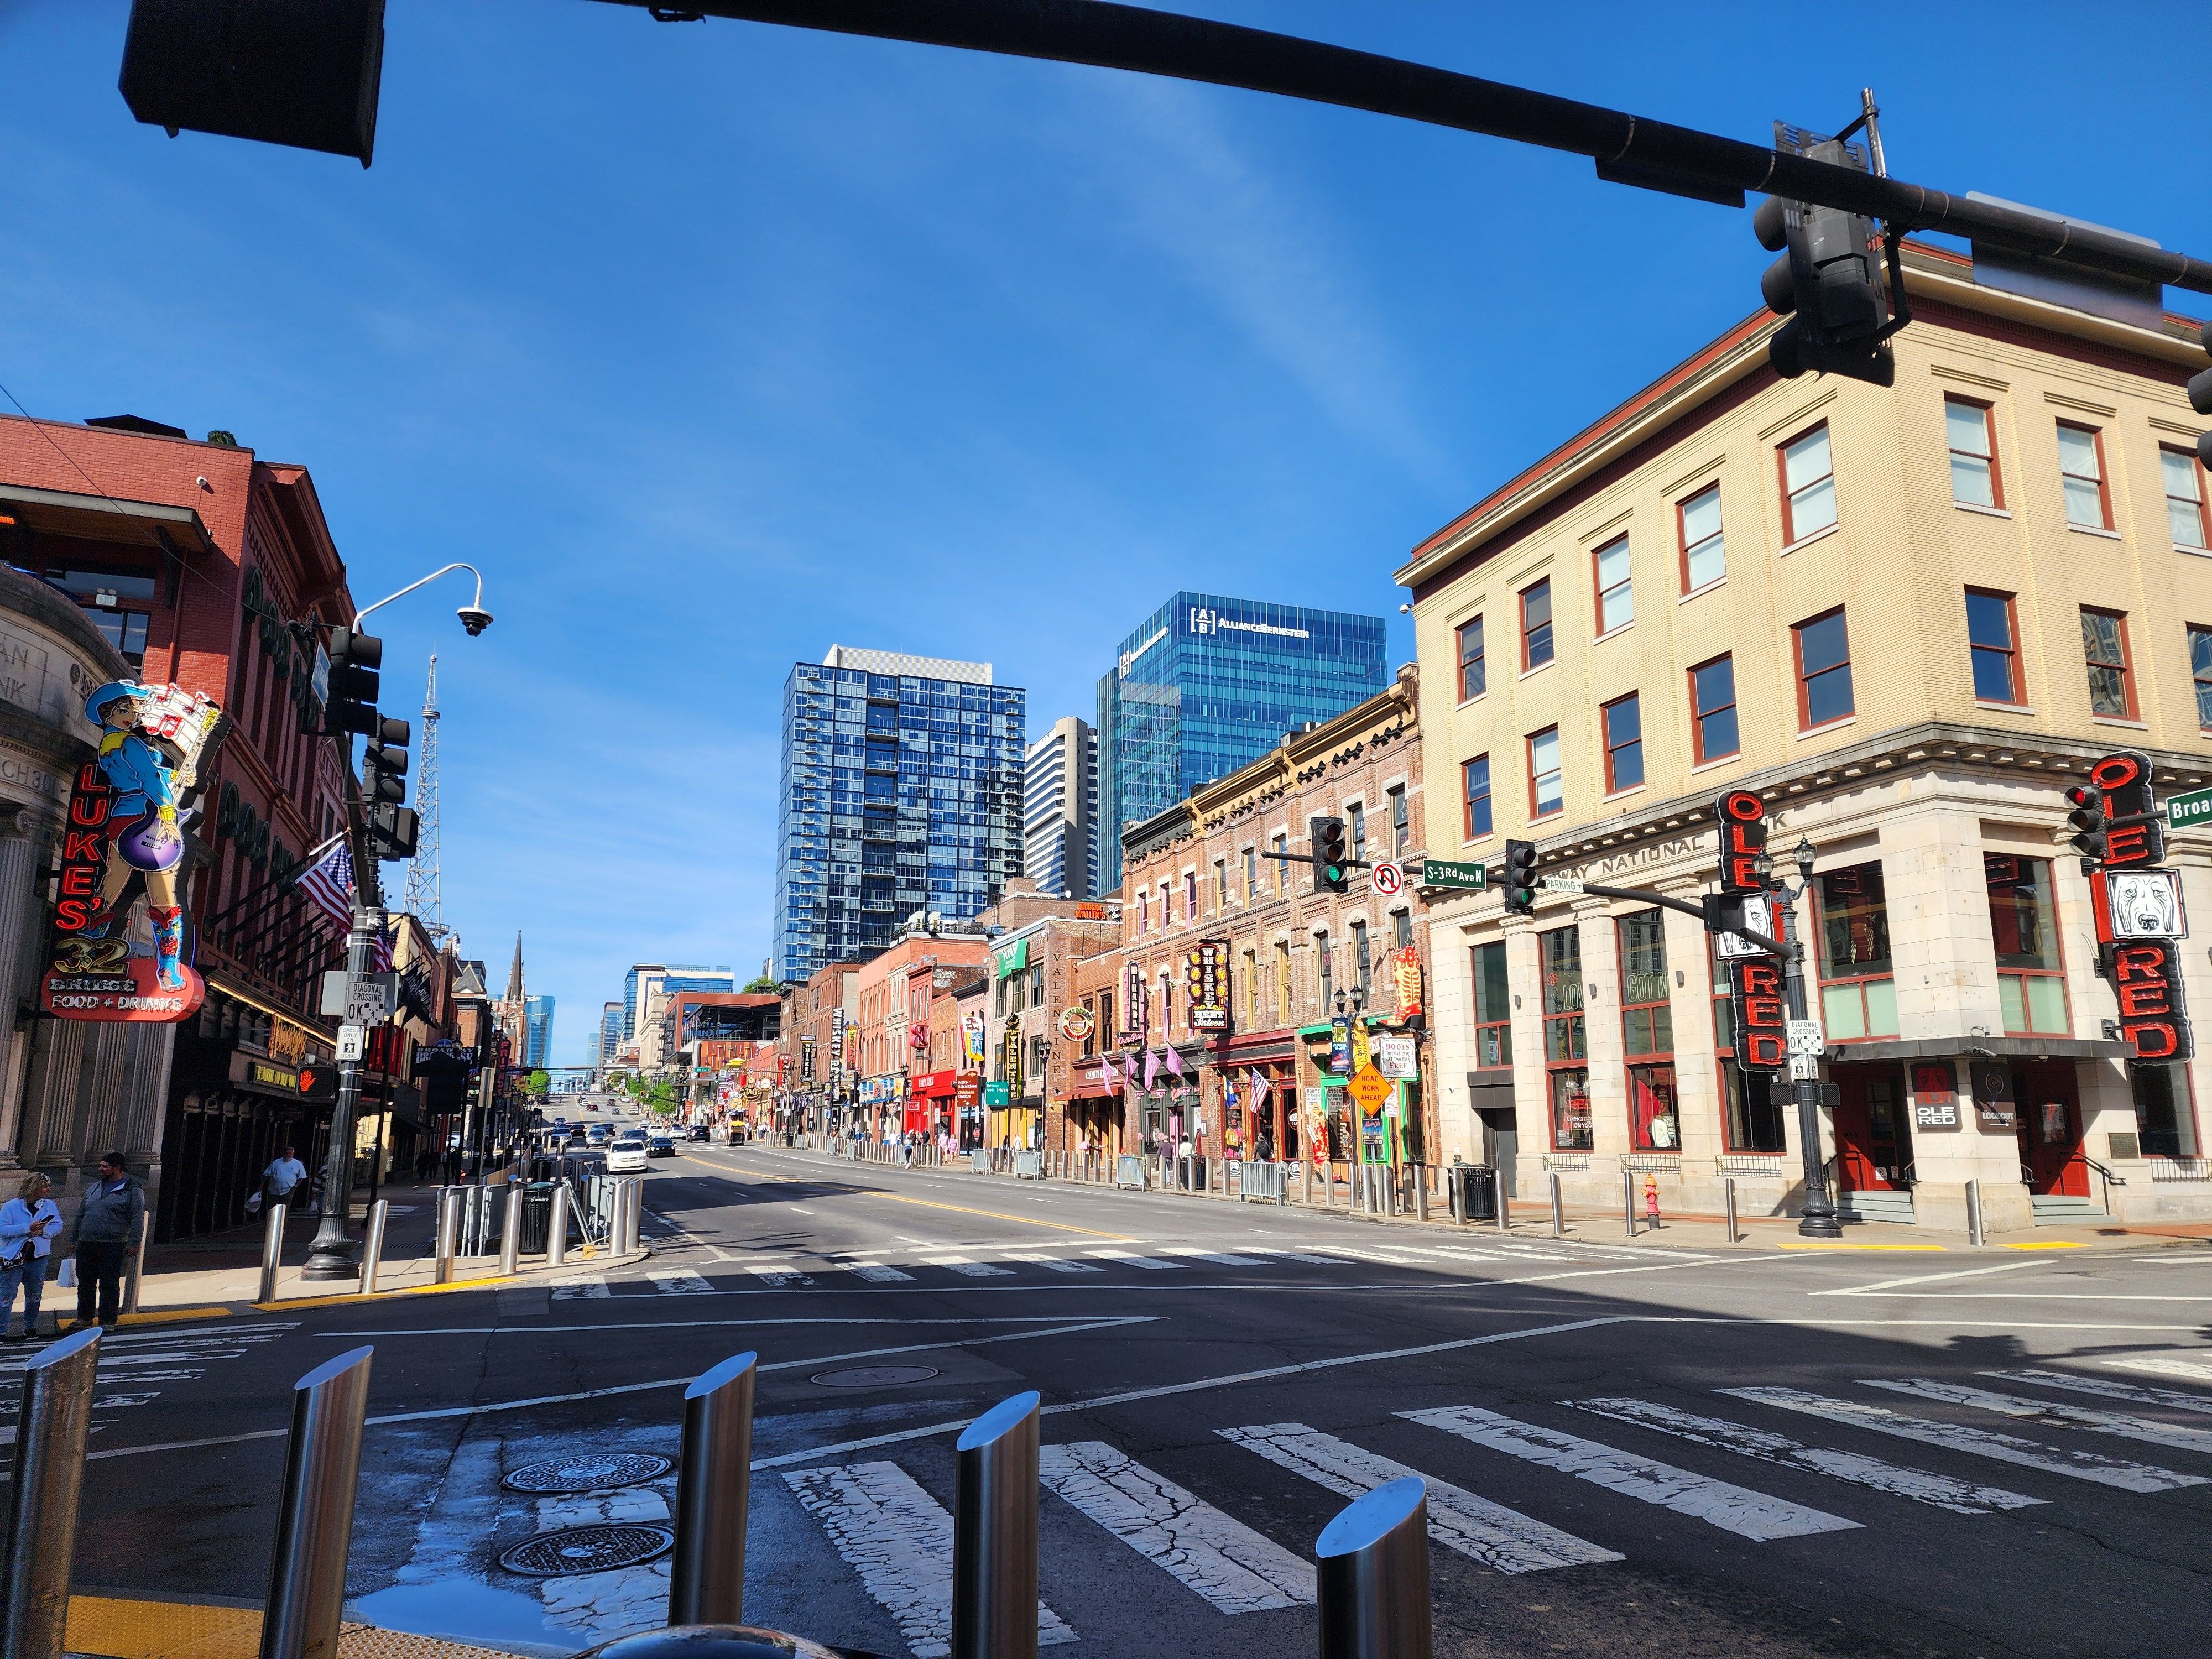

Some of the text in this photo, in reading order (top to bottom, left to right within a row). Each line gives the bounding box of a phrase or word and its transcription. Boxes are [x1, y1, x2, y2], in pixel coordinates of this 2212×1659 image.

[1198, 609, 1208, 620] A
[1199, 623, 1208, 634] B
[2172, 800, 2212, 819] Broa
[1729, 792, 1765, 888] OLE
[1602, 836, 1705, 874] NATIONAL
[1458, 872, 1474, 882] Ave
[1475, 870, 1481, 882] N
[1546, 879, 1576, 890] PARKING
[1075, 910, 1107, 920] WALLEN'S
[55, 938, 129, 976] 32
[49, 978, 135, 992] BRIDGE
[1201, 947, 1215, 1010] WHISKEY
[354, 984, 383, 994] DIAGONAL
[1627, 972, 1654, 1003] GOT
[53, 995, 98, 1009] FOOD
[118, 996, 183, 1010] DRINKS
[353, 993, 382, 1003] CROSSING
[2116, 946, 2177, 1058] RED
[348, 1004, 364, 1020] OK
[1053, 954, 1062, 1074] VALENTINE
[1194, 1010, 1225, 1019] BENT
[1744, 964, 1786, 1065] RED
[1194, 1018, 1225, 1027] Saloon
[831, 1008, 842, 1056] WHISKEY
[1790, 1037, 1803, 1049] OK
[1009, 1035, 1018, 1098] VALENTINE
[1086, 1070, 1100, 1080] CANDY
[1917, 1107, 1955, 1116] OLE
[1918, 1115, 1956, 1125] RED
